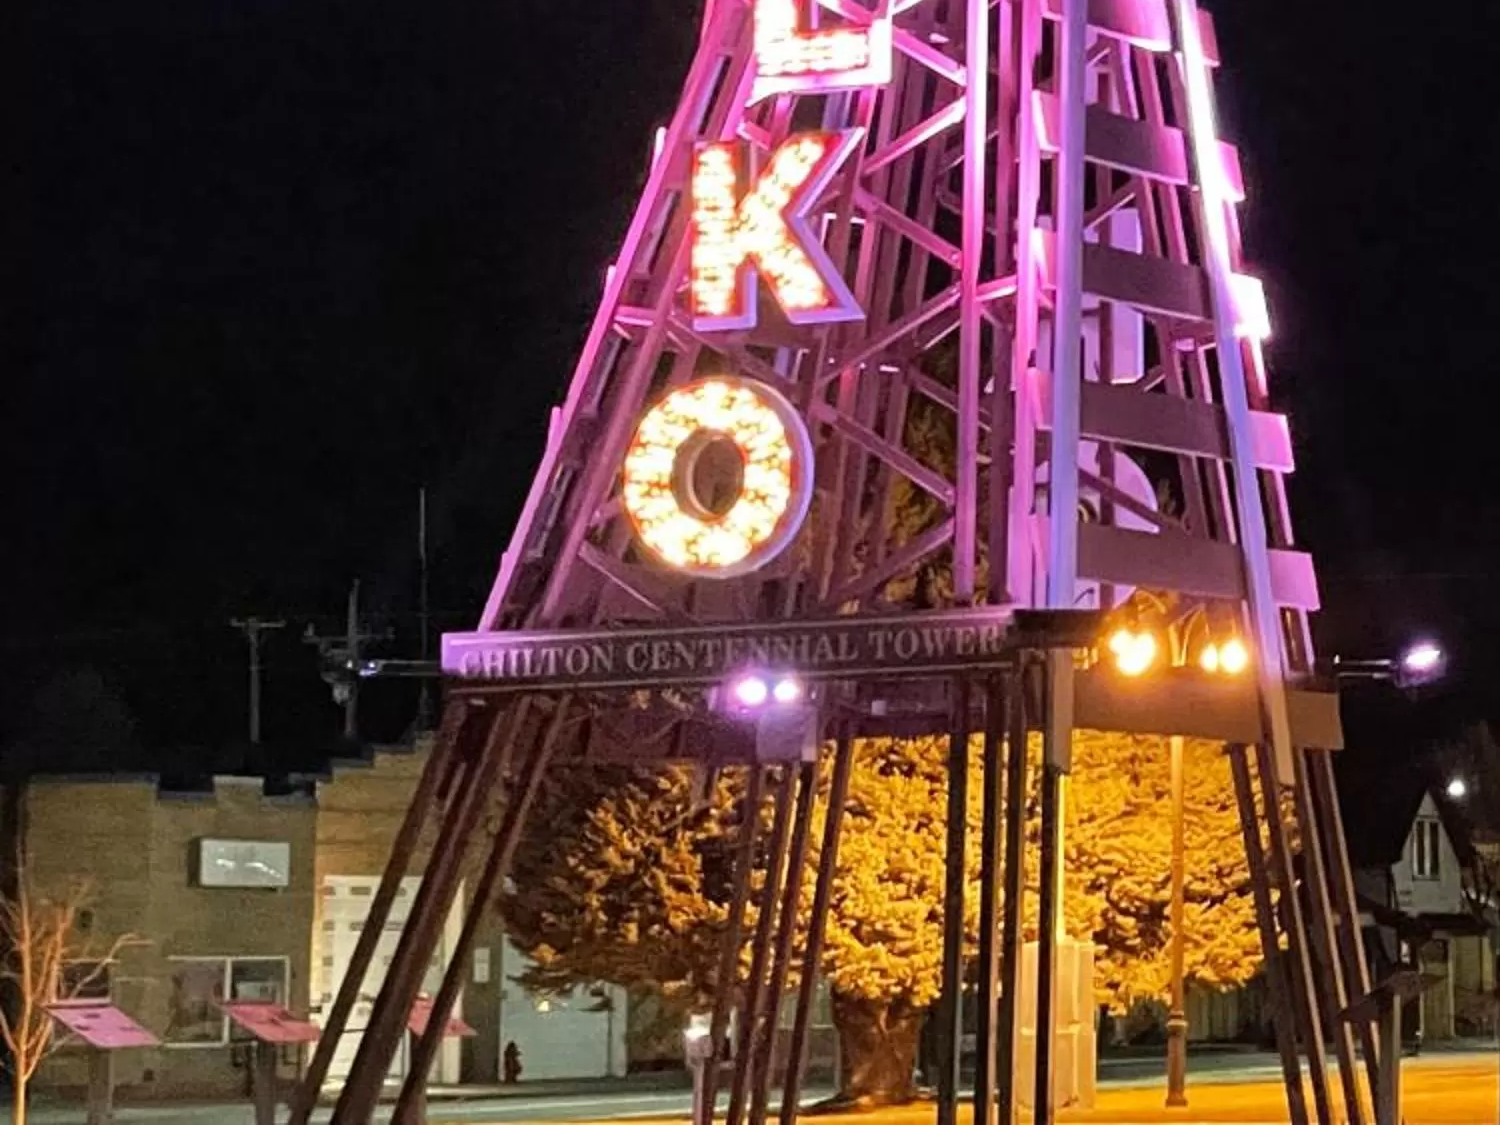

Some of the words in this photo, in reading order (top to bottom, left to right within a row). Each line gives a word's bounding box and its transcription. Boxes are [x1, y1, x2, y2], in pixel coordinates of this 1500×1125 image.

[460, 644, 615, 679] CHILTON
[626, 632, 859, 674] CENTENNIAL
[867, 623, 1005, 661] TOWER
